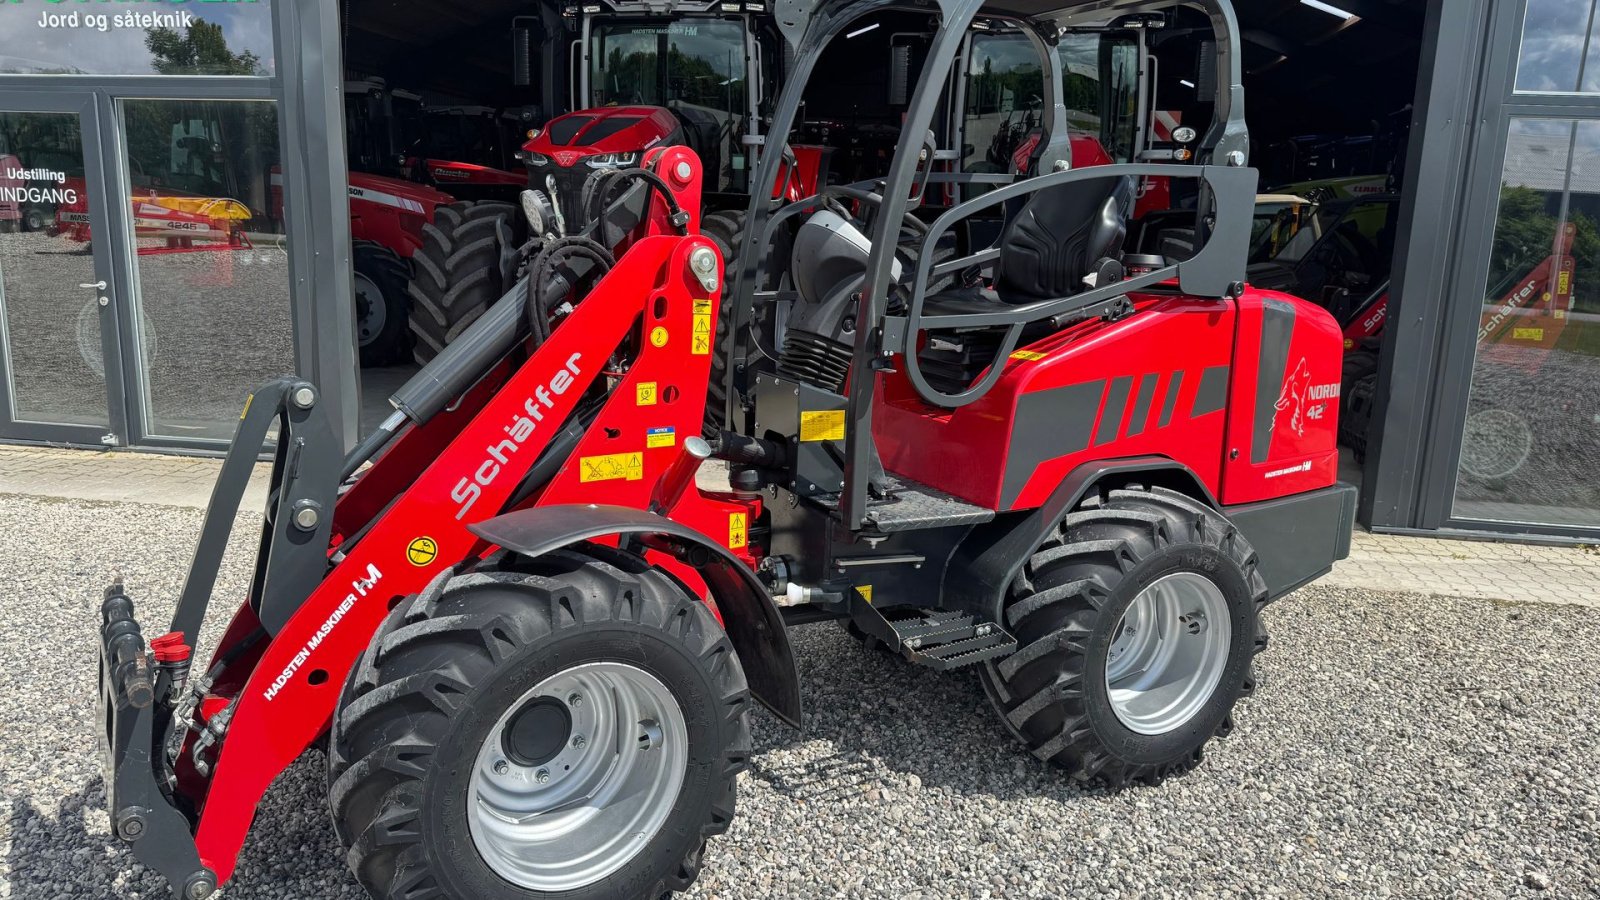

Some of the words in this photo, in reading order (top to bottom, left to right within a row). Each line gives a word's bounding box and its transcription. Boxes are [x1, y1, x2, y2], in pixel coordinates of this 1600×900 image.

[37, 11, 79, 28] Jord
[84, 14, 108, 32] og
[113, 10, 193, 28] såteknik
[7, 167, 66, 184] Udstilling
[0, 186, 77, 204] INDGANG
[167, 221, 198, 230] 4245
[1363, 303, 1387, 333] Sch
[1476, 280, 1536, 343] Schäffer
[451, 352, 582, 520] Schäffer
[263, 646, 310, 702] HADSTEN
[307, 592, 358, 652] MASKINER
